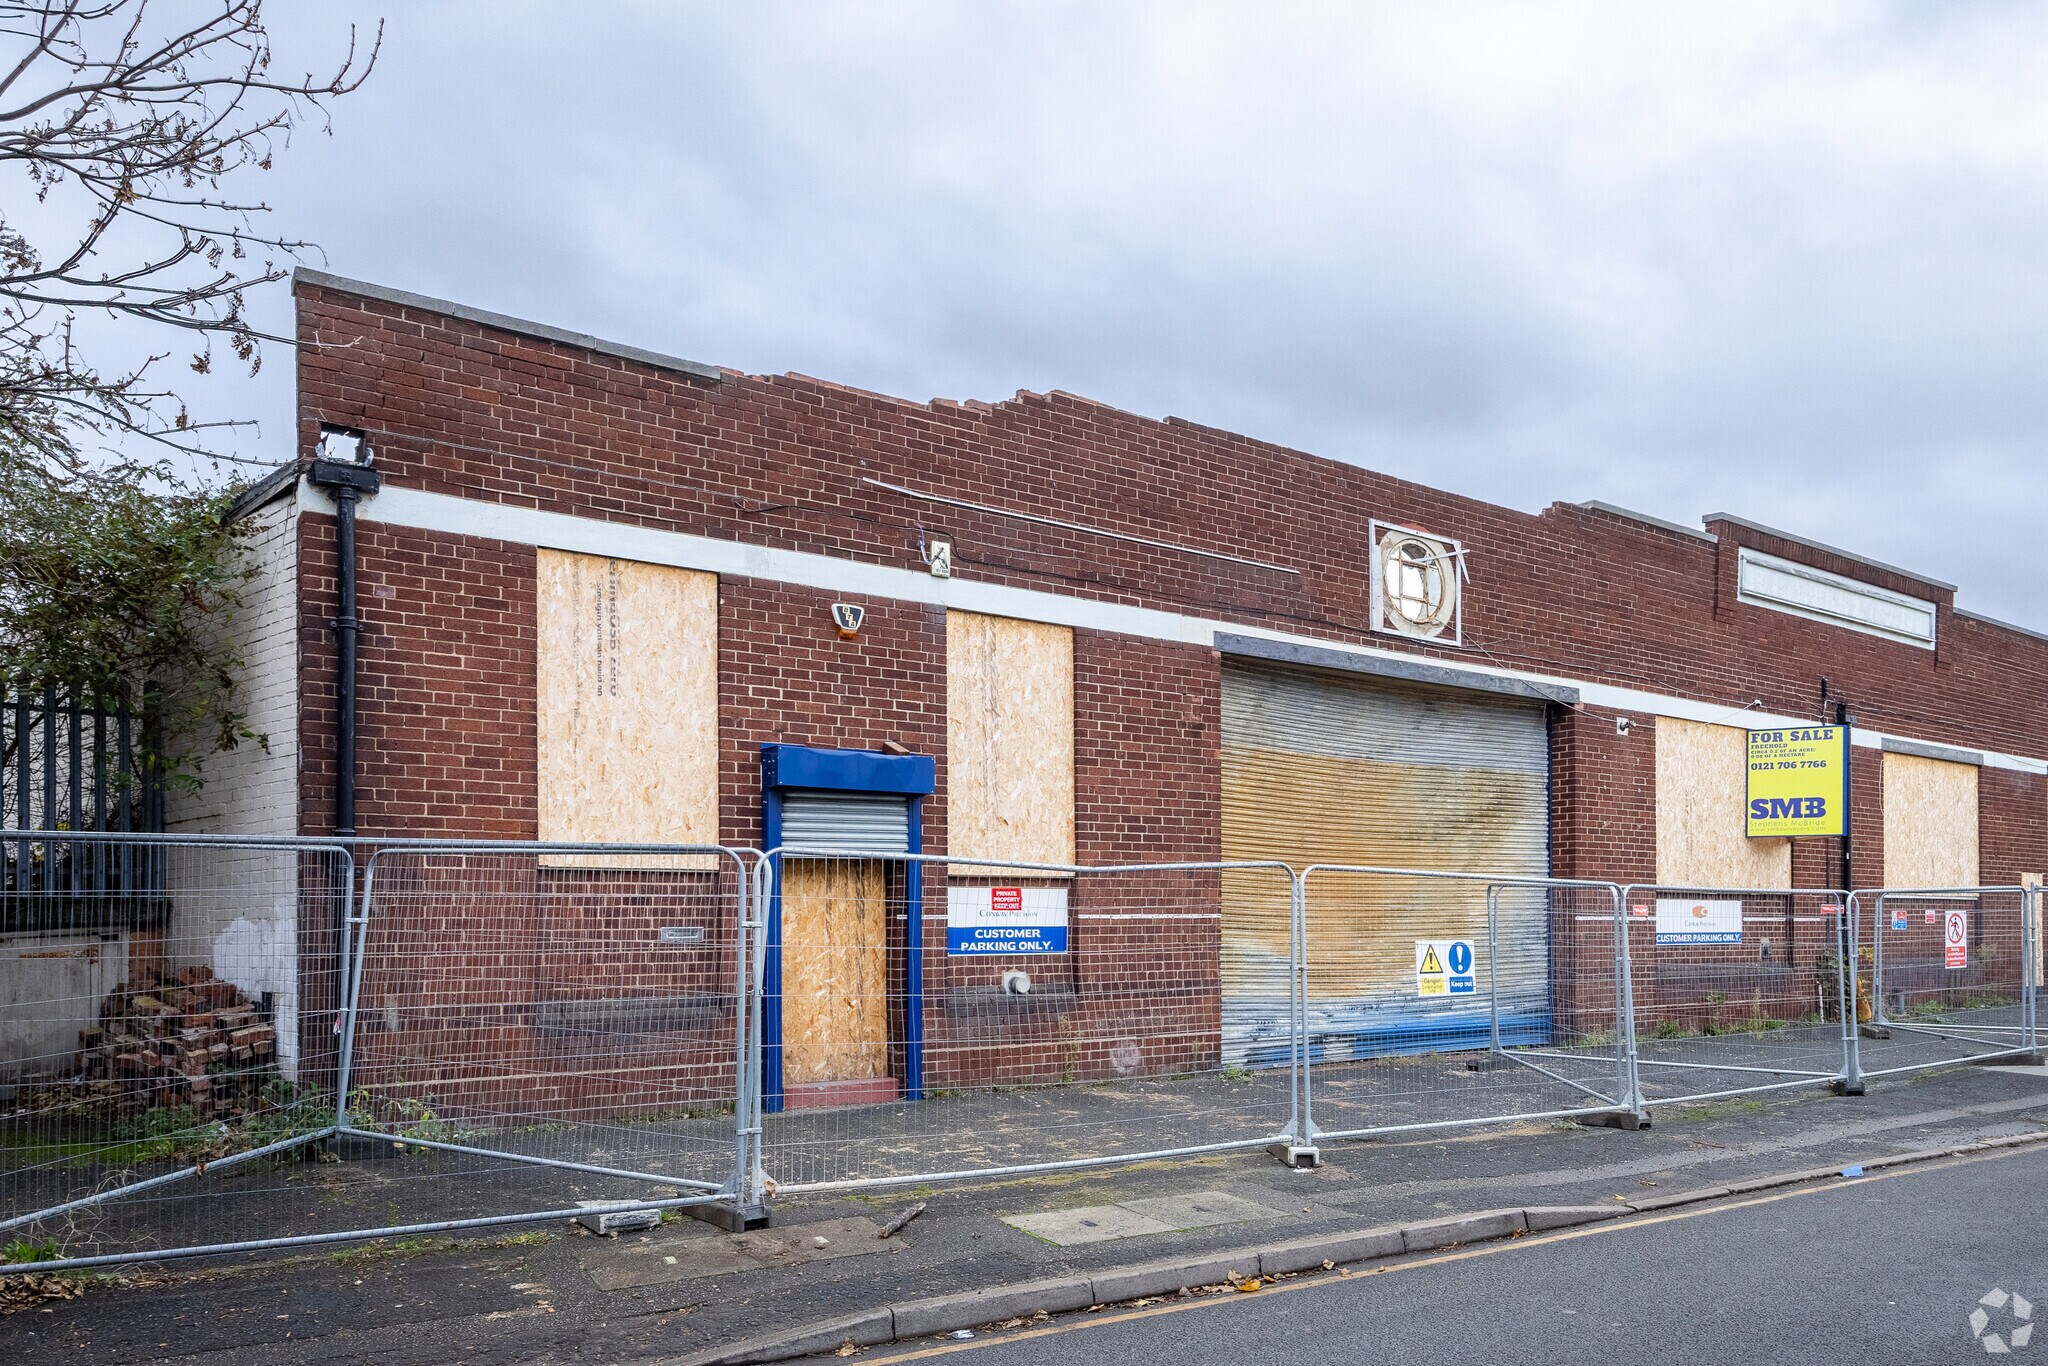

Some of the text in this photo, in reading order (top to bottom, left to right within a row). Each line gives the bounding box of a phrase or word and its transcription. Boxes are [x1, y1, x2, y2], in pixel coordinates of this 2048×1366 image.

[598, 685, 603, 696] on
[1751, 730, 1834, 743] FOR SALE
[1750, 797, 1826, 819] SMB
[974, 929, 1041, 938] CUSTOMER
[960, 941, 1054, 951] PARKING ONLY.
